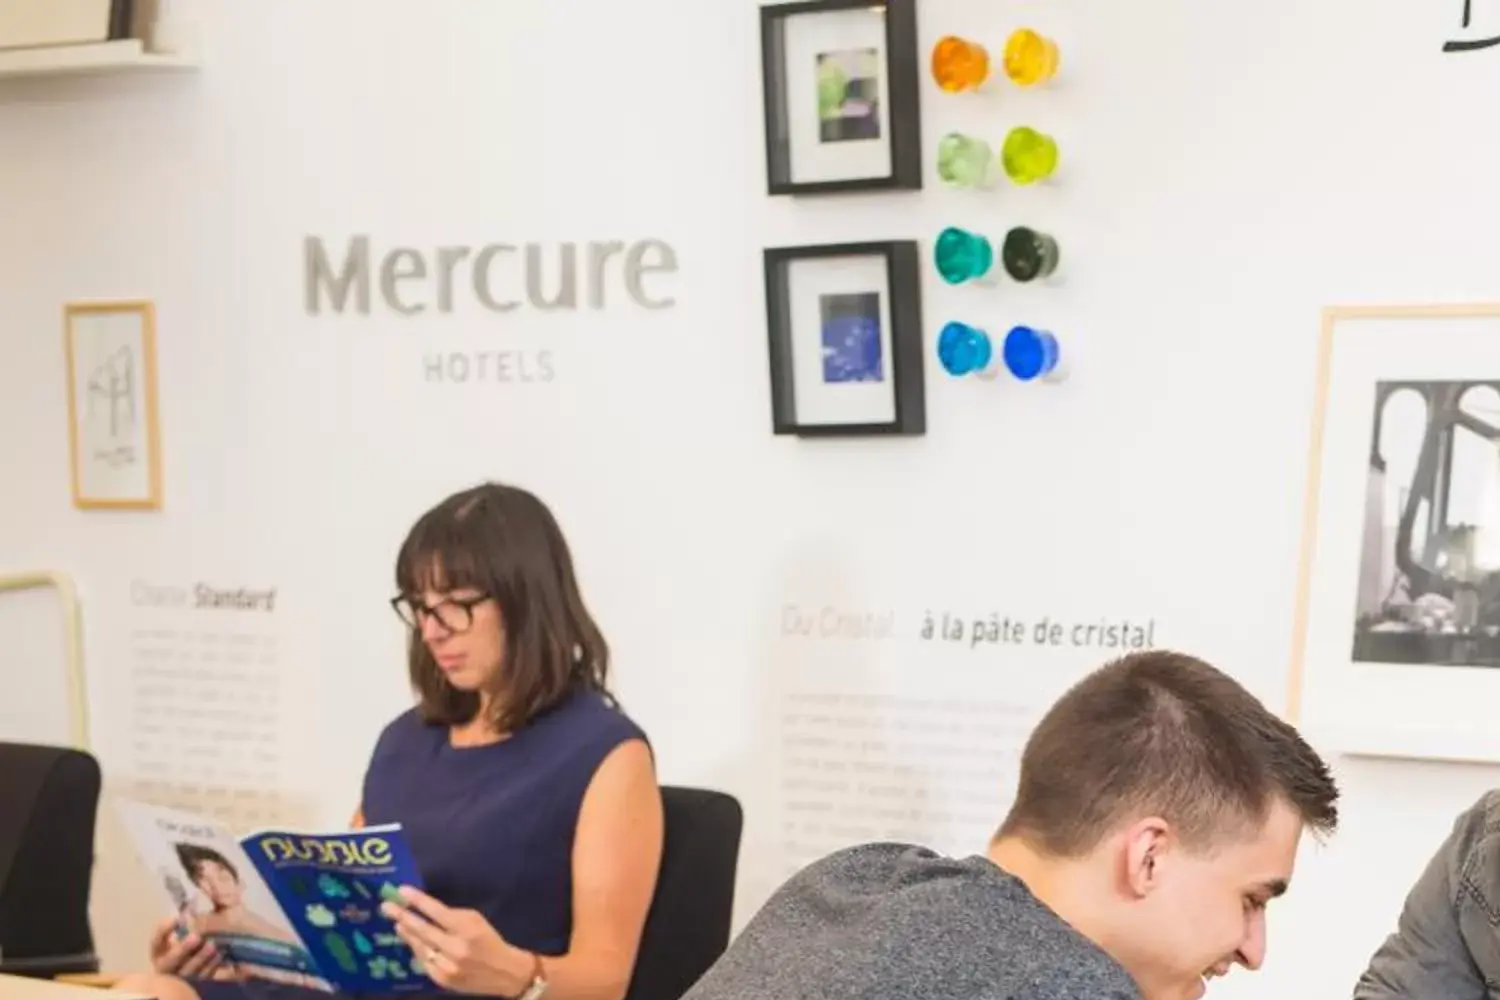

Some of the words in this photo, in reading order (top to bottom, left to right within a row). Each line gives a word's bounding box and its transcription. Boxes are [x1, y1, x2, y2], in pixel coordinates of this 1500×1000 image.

[303, 233, 680, 317] Mercure
[423, 349, 556, 383] HOTELS
[193, 581, 278, 613] Standard
[920, 608, 936, 641] à
[941, 611, 964, 642] la
[971, 611, 1025, 650] pâte
[1032, 616, 1064, 647] de
[1070, 617, 1155, 649] cristal
